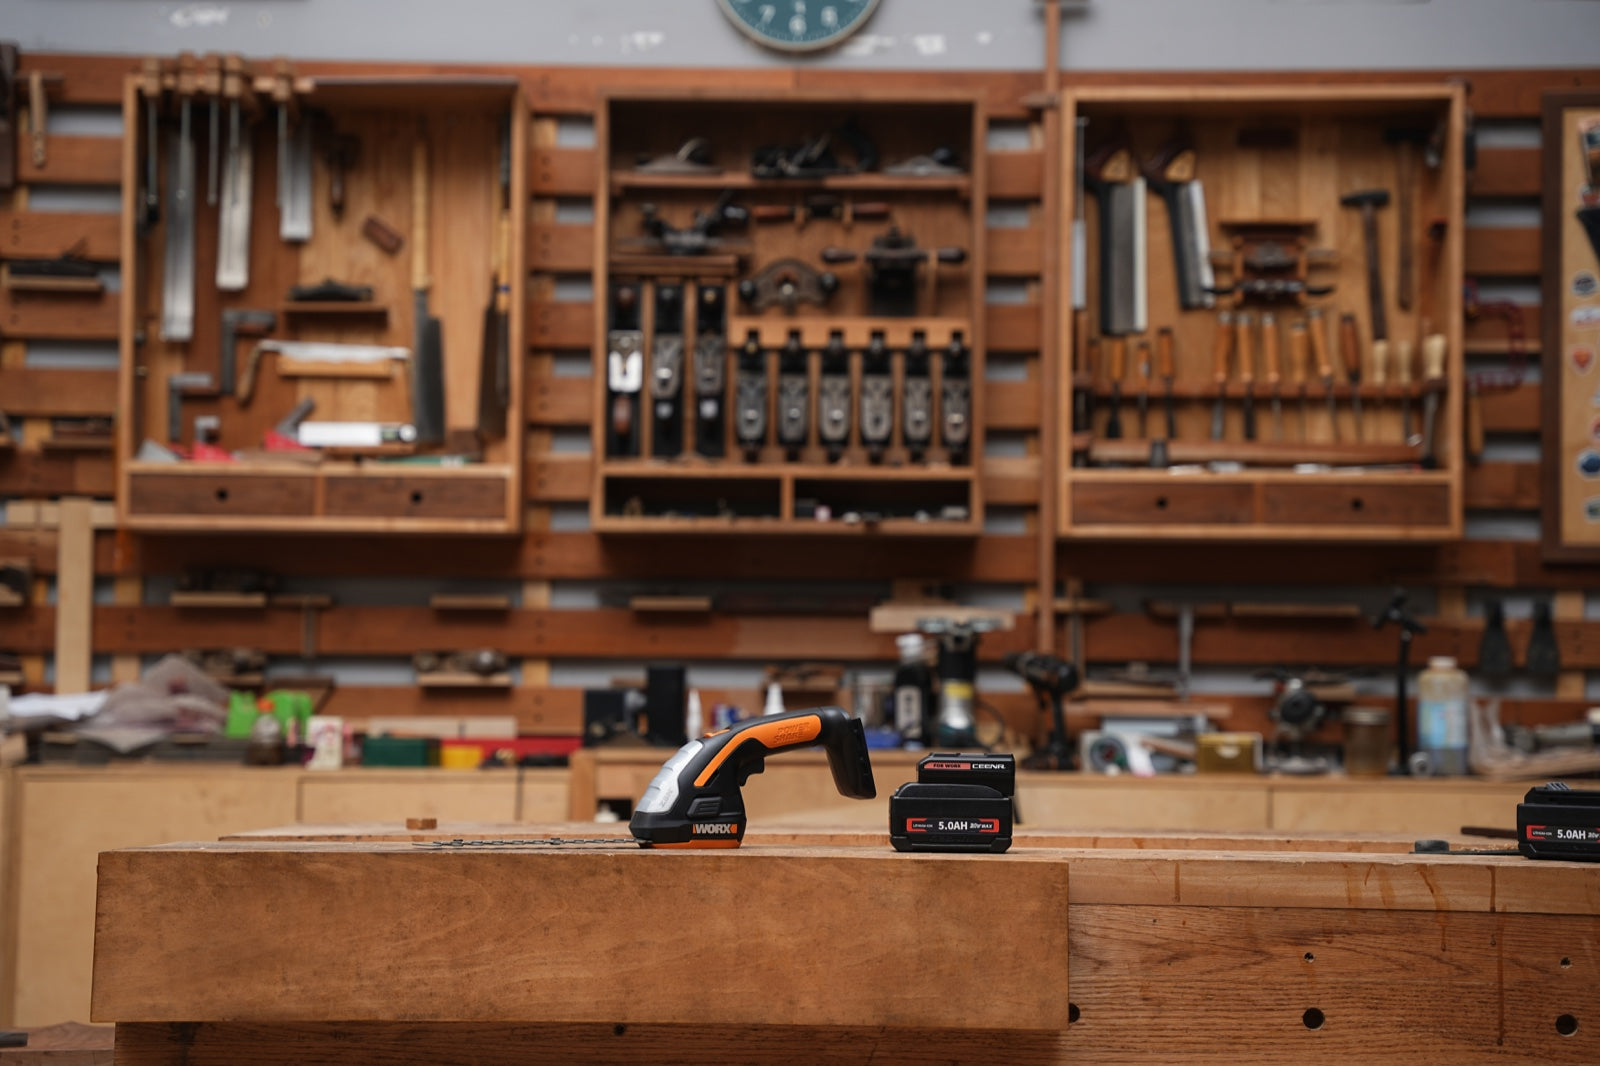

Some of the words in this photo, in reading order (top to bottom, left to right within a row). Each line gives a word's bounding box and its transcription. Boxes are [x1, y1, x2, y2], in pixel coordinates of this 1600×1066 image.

[760, 4, 776, 24] 7
[777, 722, 810, 734] POWER
[773, 731, 804, 744] SHARE
[695, 823, 731, 834] WORX
[938, 821, 968, 831] 5.0AH
[1557, 829, 1586, 839] 5.0AH
